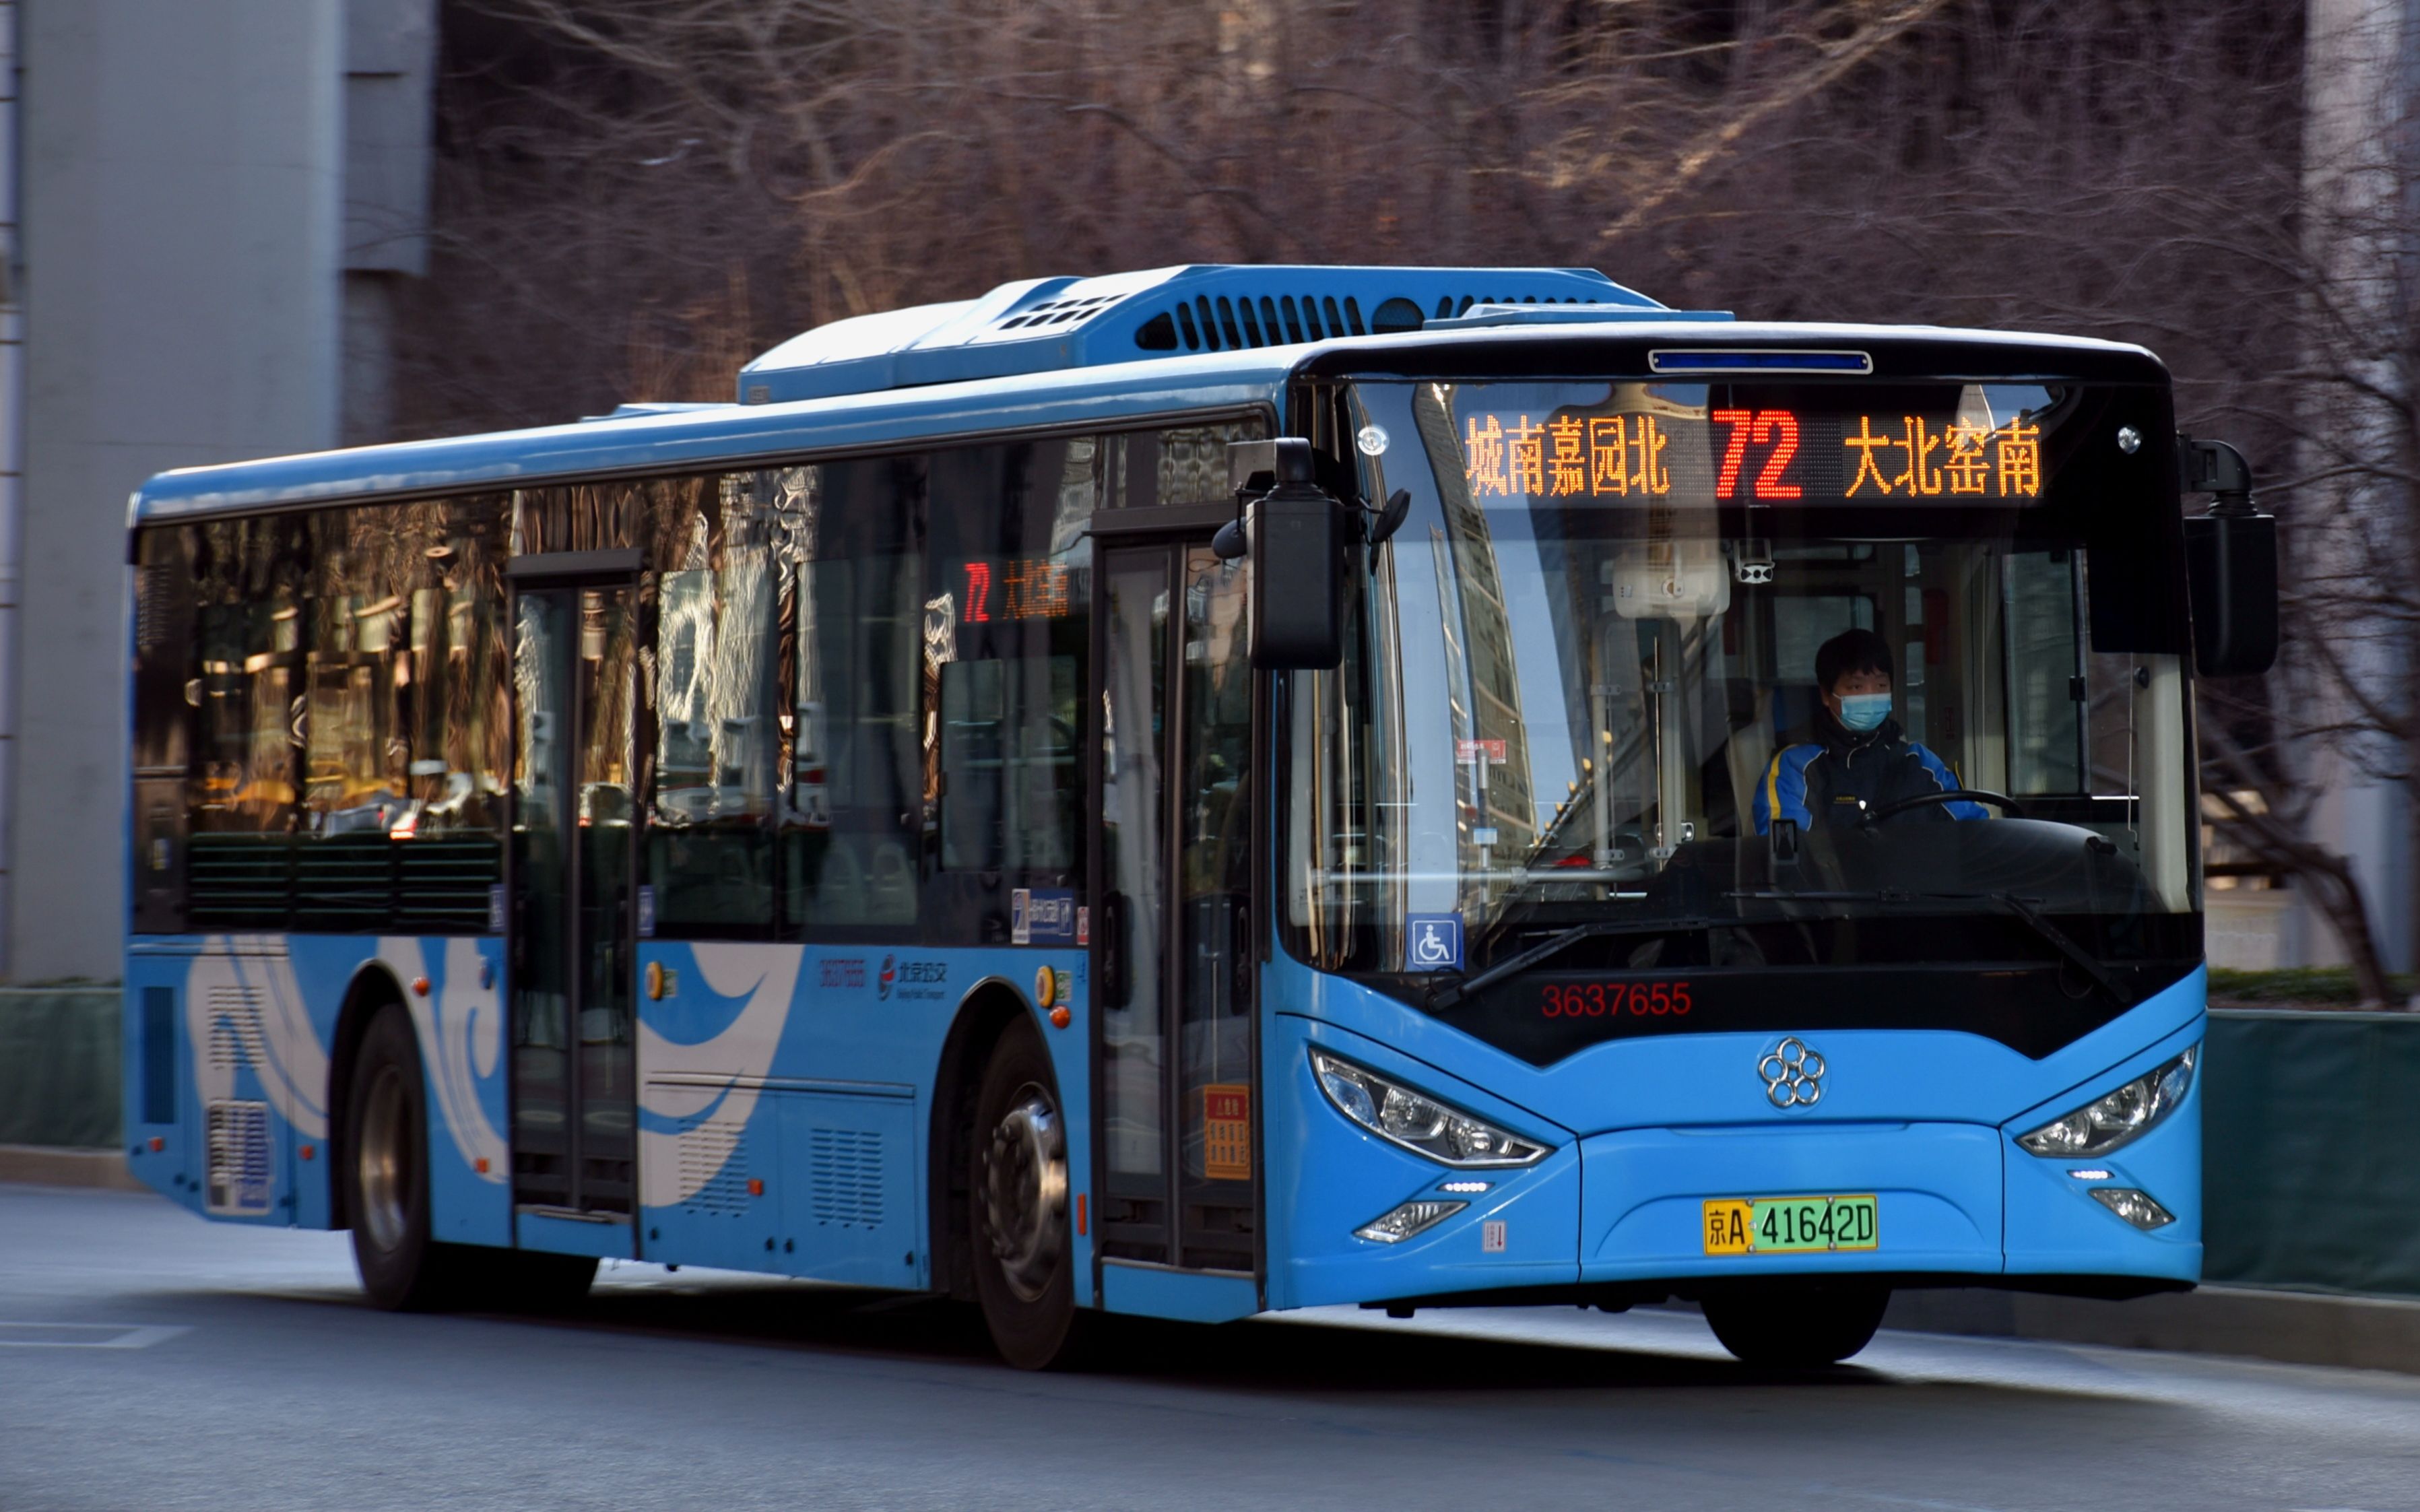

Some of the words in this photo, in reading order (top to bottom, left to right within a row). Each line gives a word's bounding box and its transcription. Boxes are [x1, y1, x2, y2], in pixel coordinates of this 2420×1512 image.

[1465, 415, 1670, 497] 城南嘉园北
[1713, 409, 1802, 498] 72
[1845, 416, 2041, 497] 大北窑南
[964, 562, 990, 622] 72
[1542, 982, 1692, 1018] 3637655
[1709, 1208, 1746, 1245] 京A
[1761, 1203, 1873, 1245] 41642D
